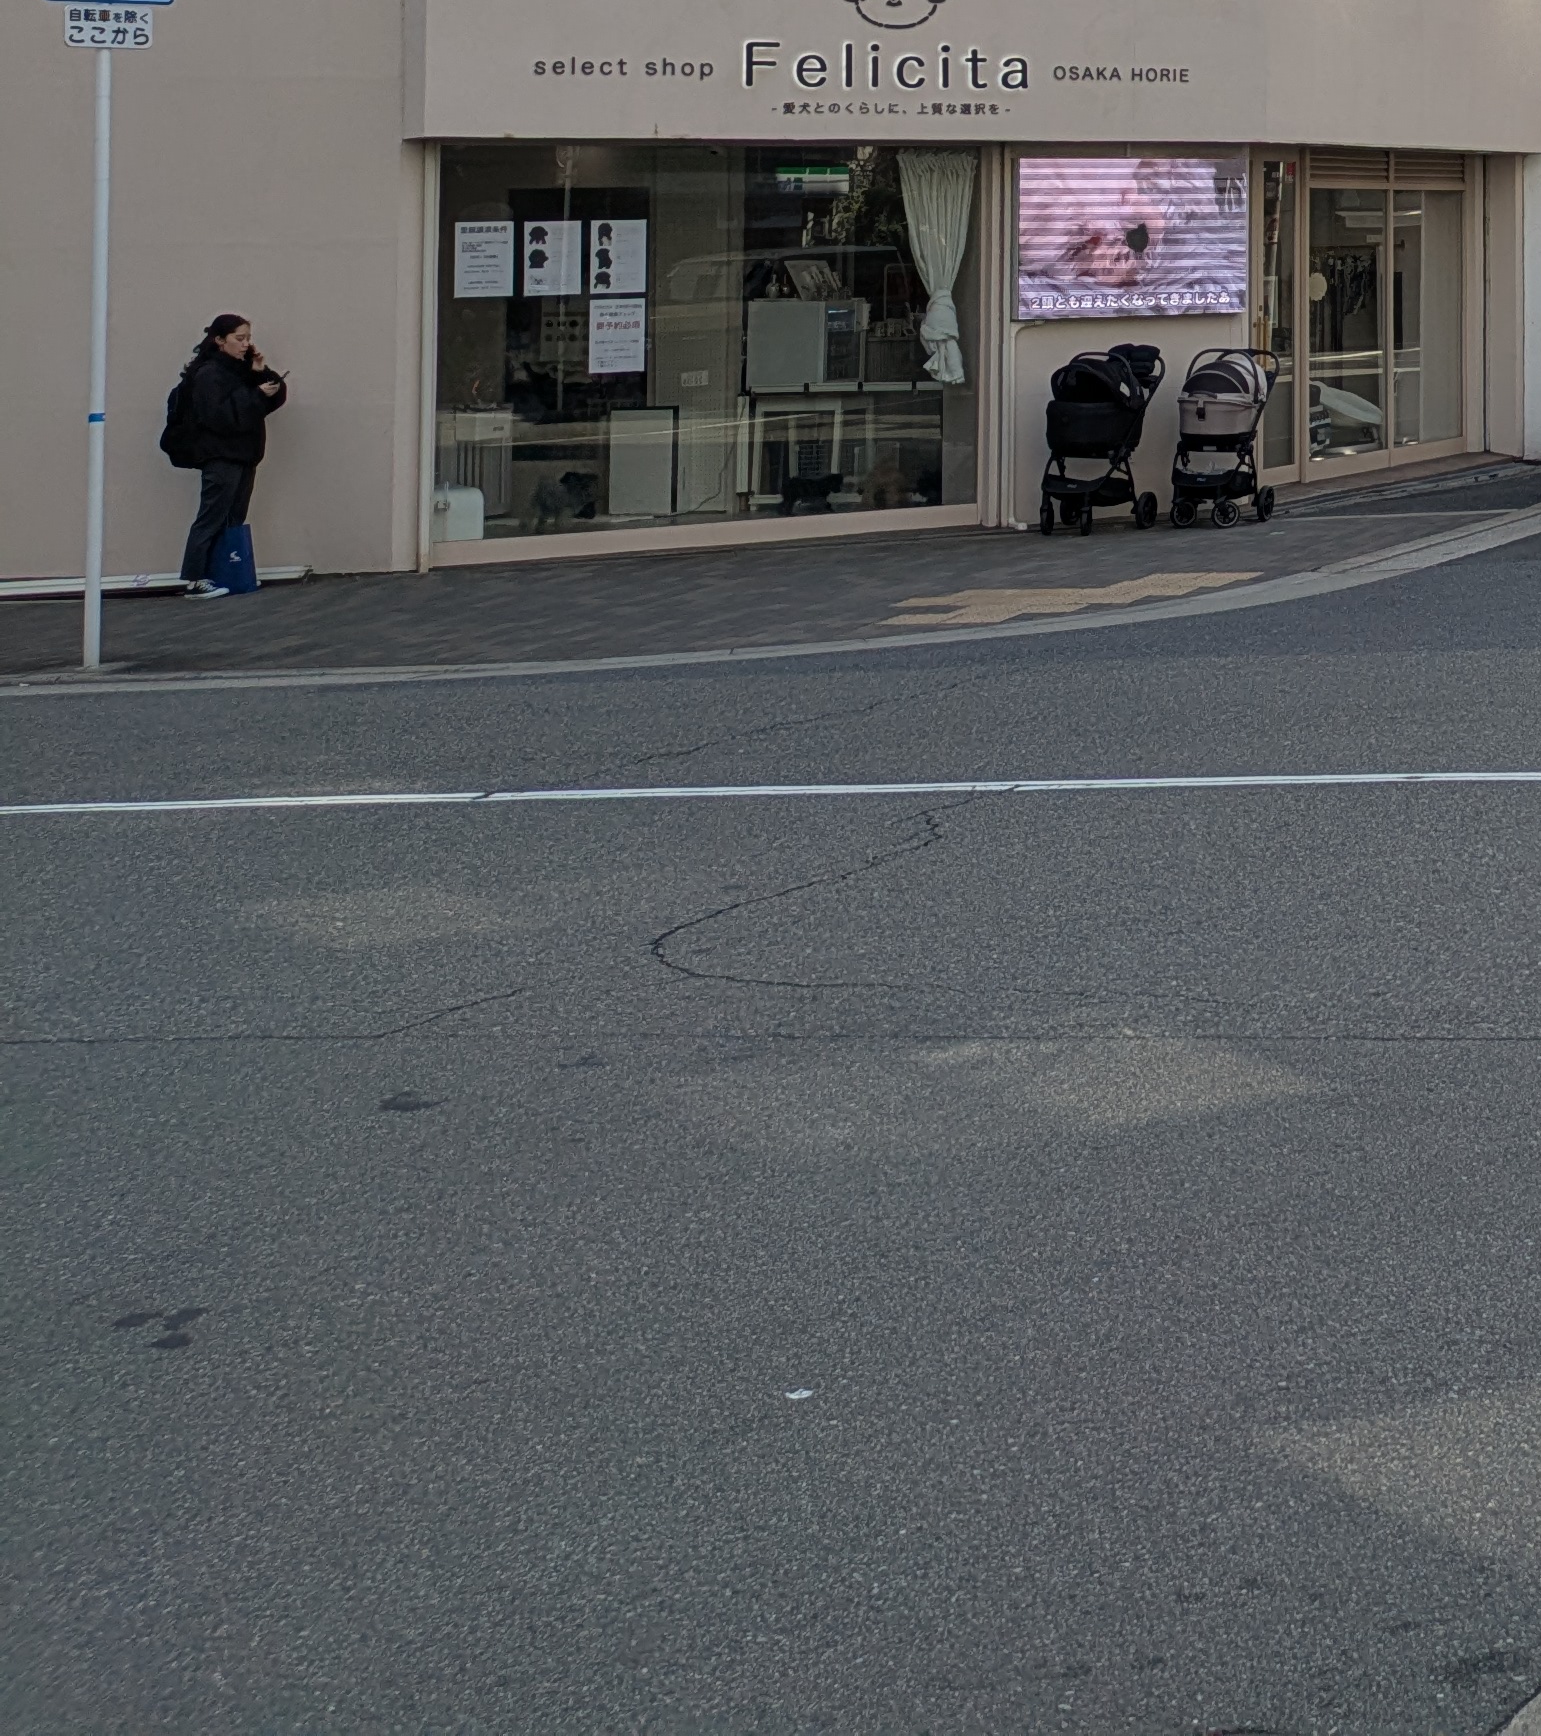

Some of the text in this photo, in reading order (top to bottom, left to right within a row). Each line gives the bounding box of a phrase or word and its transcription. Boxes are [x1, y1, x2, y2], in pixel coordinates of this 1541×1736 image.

[69, 8, 149, 24] 自転車を除く
[68, 25, 150, 46] ここから
[533, 56, 715, 82] select shop
[742, 41, 1029, 90] Felicita
[1053, 64, 1190, 83] OSAKA HORIE
